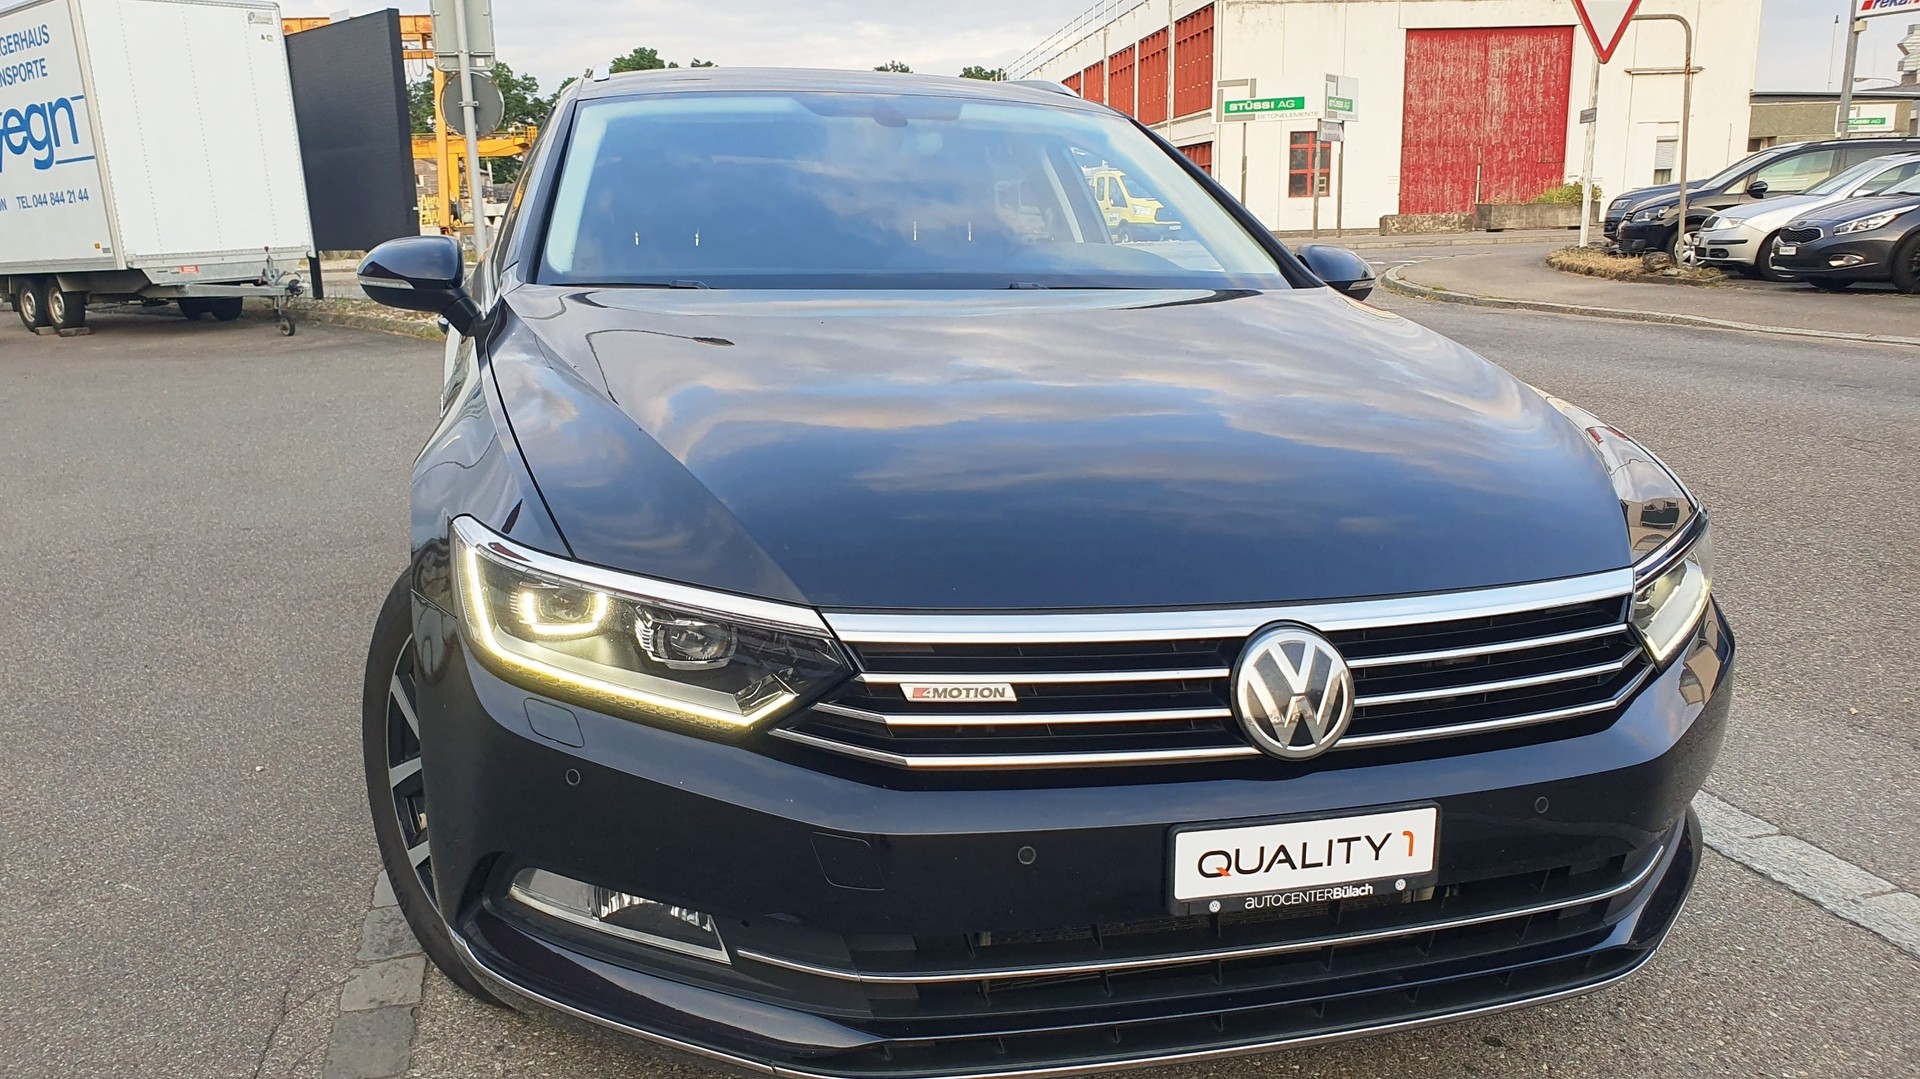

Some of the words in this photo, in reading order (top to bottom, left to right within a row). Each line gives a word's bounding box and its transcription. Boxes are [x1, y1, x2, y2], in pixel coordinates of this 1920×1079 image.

[0, 24, 50, 56] GERHAUS
[1229, 100, 1275, 111] STÜSSI
[1277, 99, 1296, 109] AG
[1257, 111, 1319, 119] BETONELEMENTE
[50, 191, 66, 206] 844
[67, 190, 76, 204] 21
[78, 188, 89, 201] 44
[914, 687, 1006, 699] 4MOTION
[1197, 832, 1392, 879] QUALITY
[1402, 830, 1414, 857] 1
